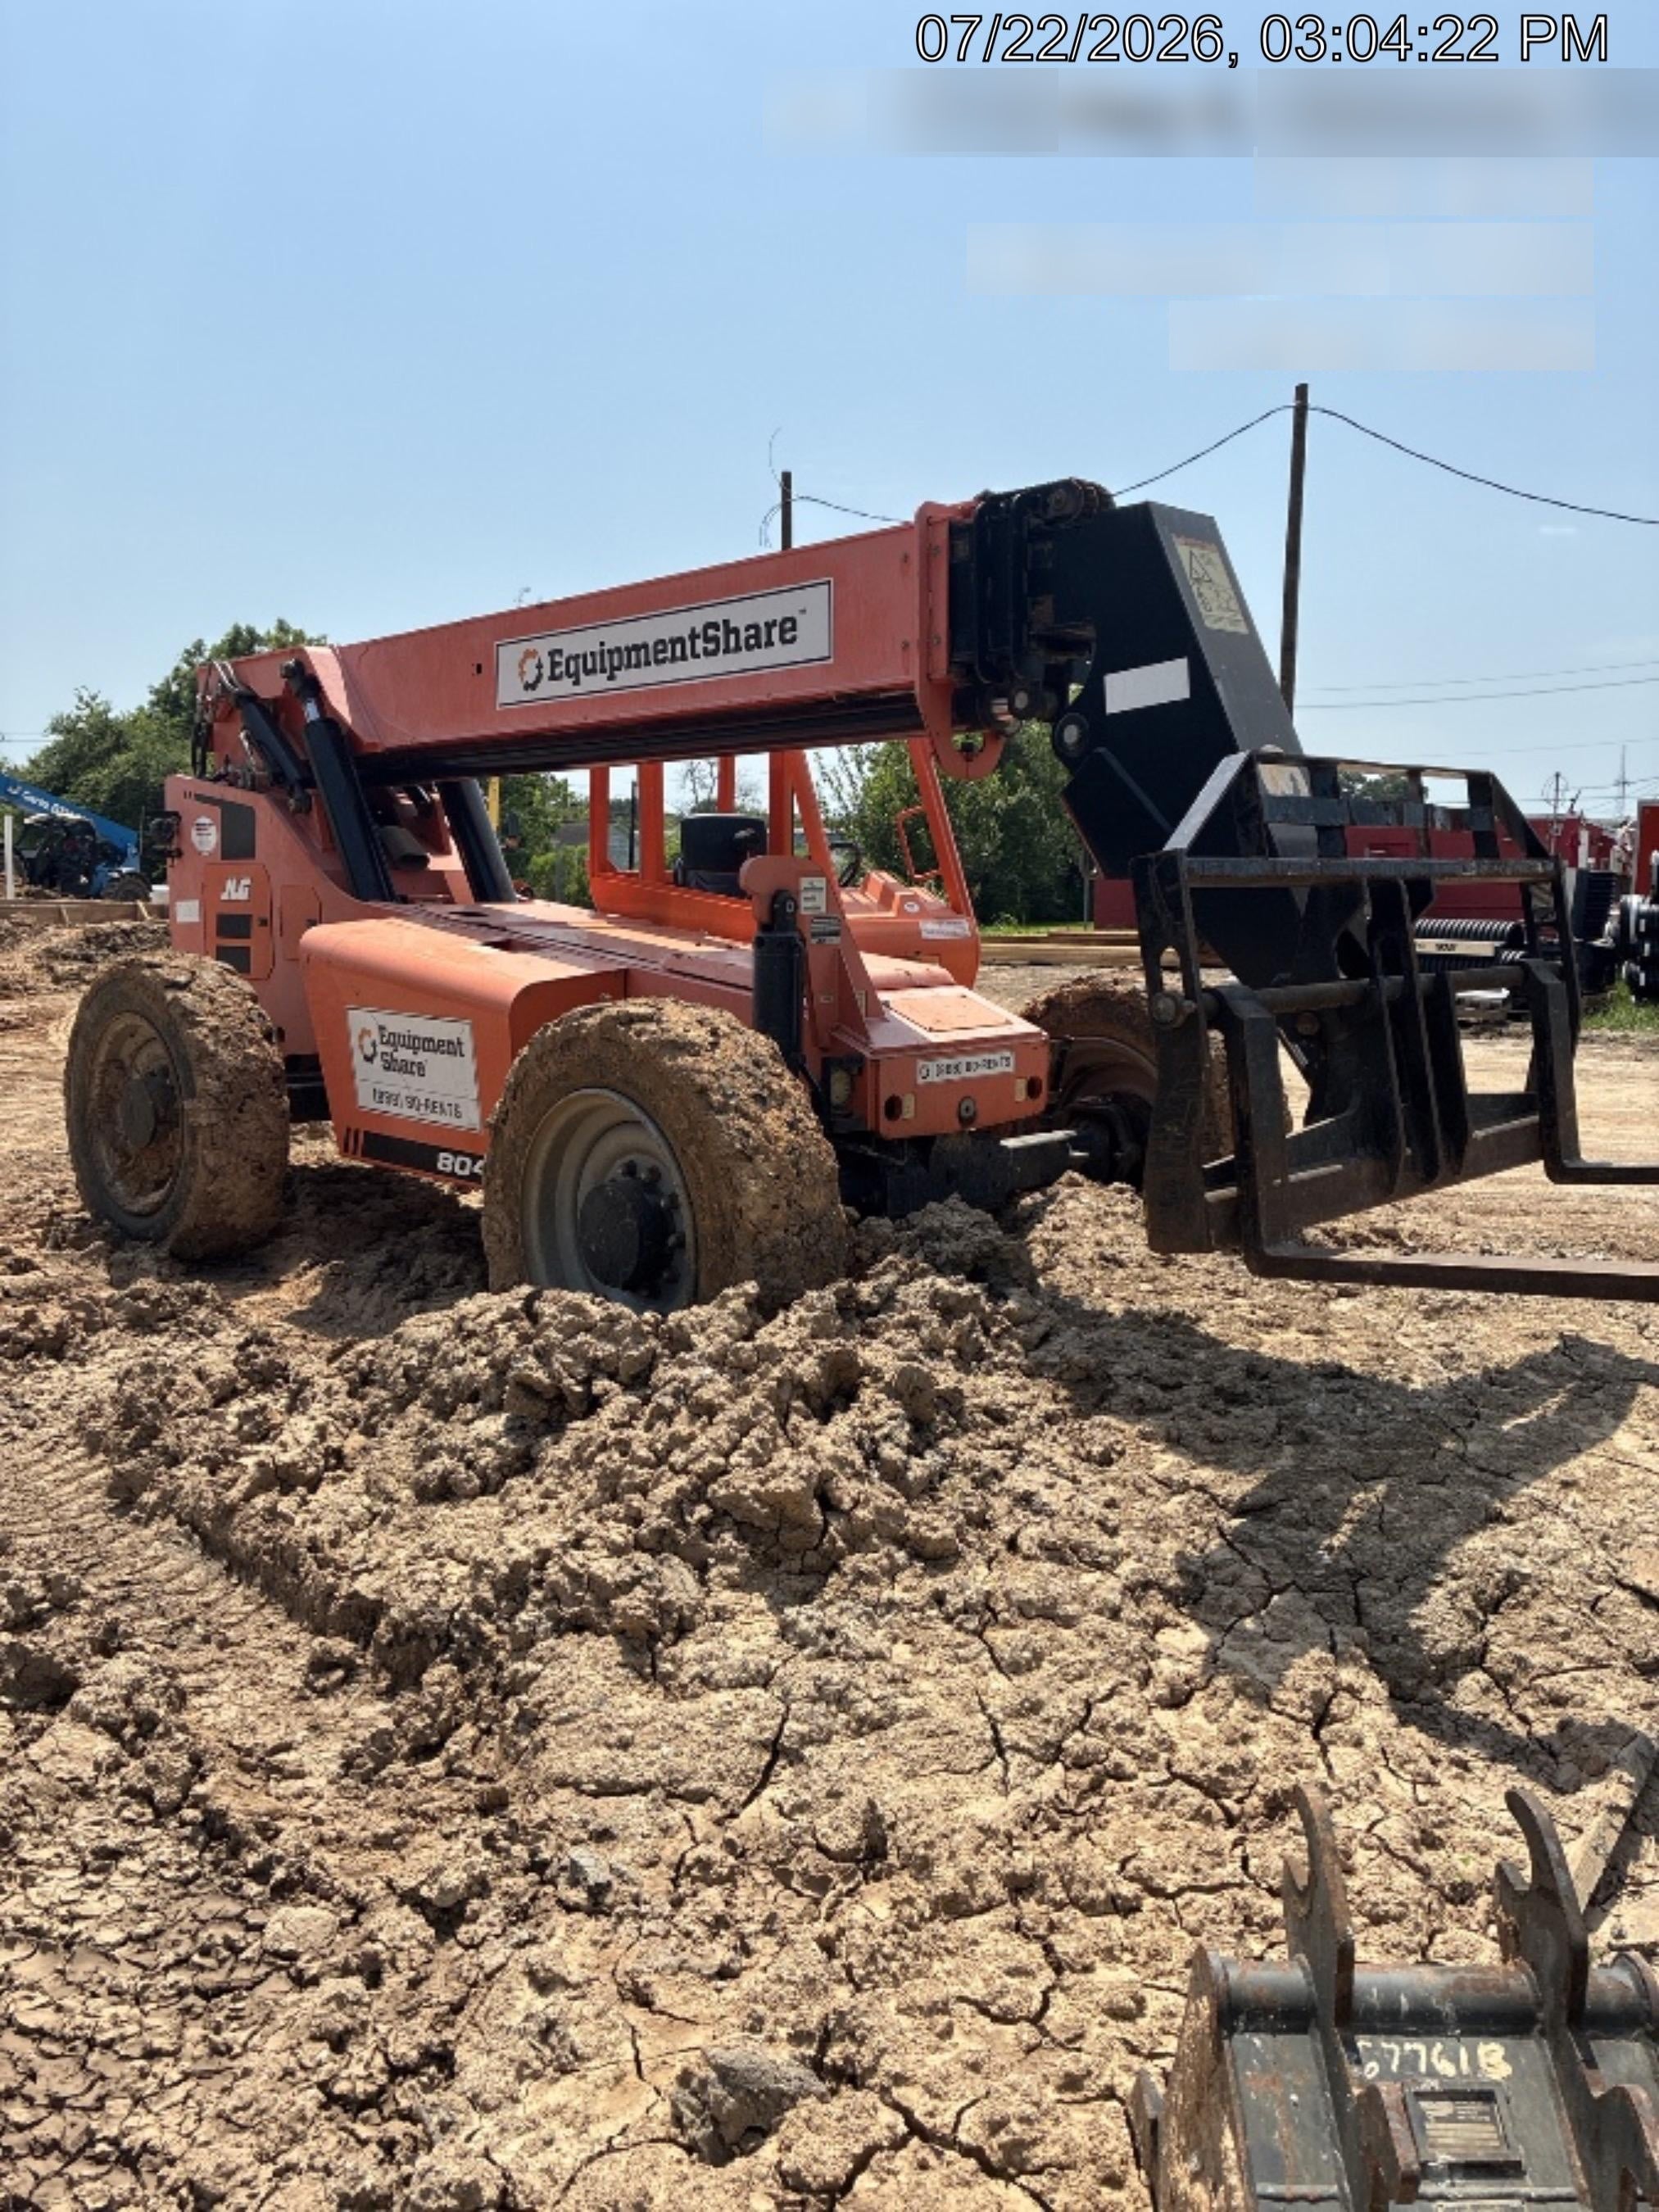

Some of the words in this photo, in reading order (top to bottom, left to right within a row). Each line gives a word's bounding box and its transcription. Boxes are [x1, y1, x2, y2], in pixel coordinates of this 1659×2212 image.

[547, 616, 798, 686] EquipmentShare
[220, 877, 252, 900] JLG
[378, 1025, 465, 1057] Equipment
[381, 1052, 426, 1077] Share
